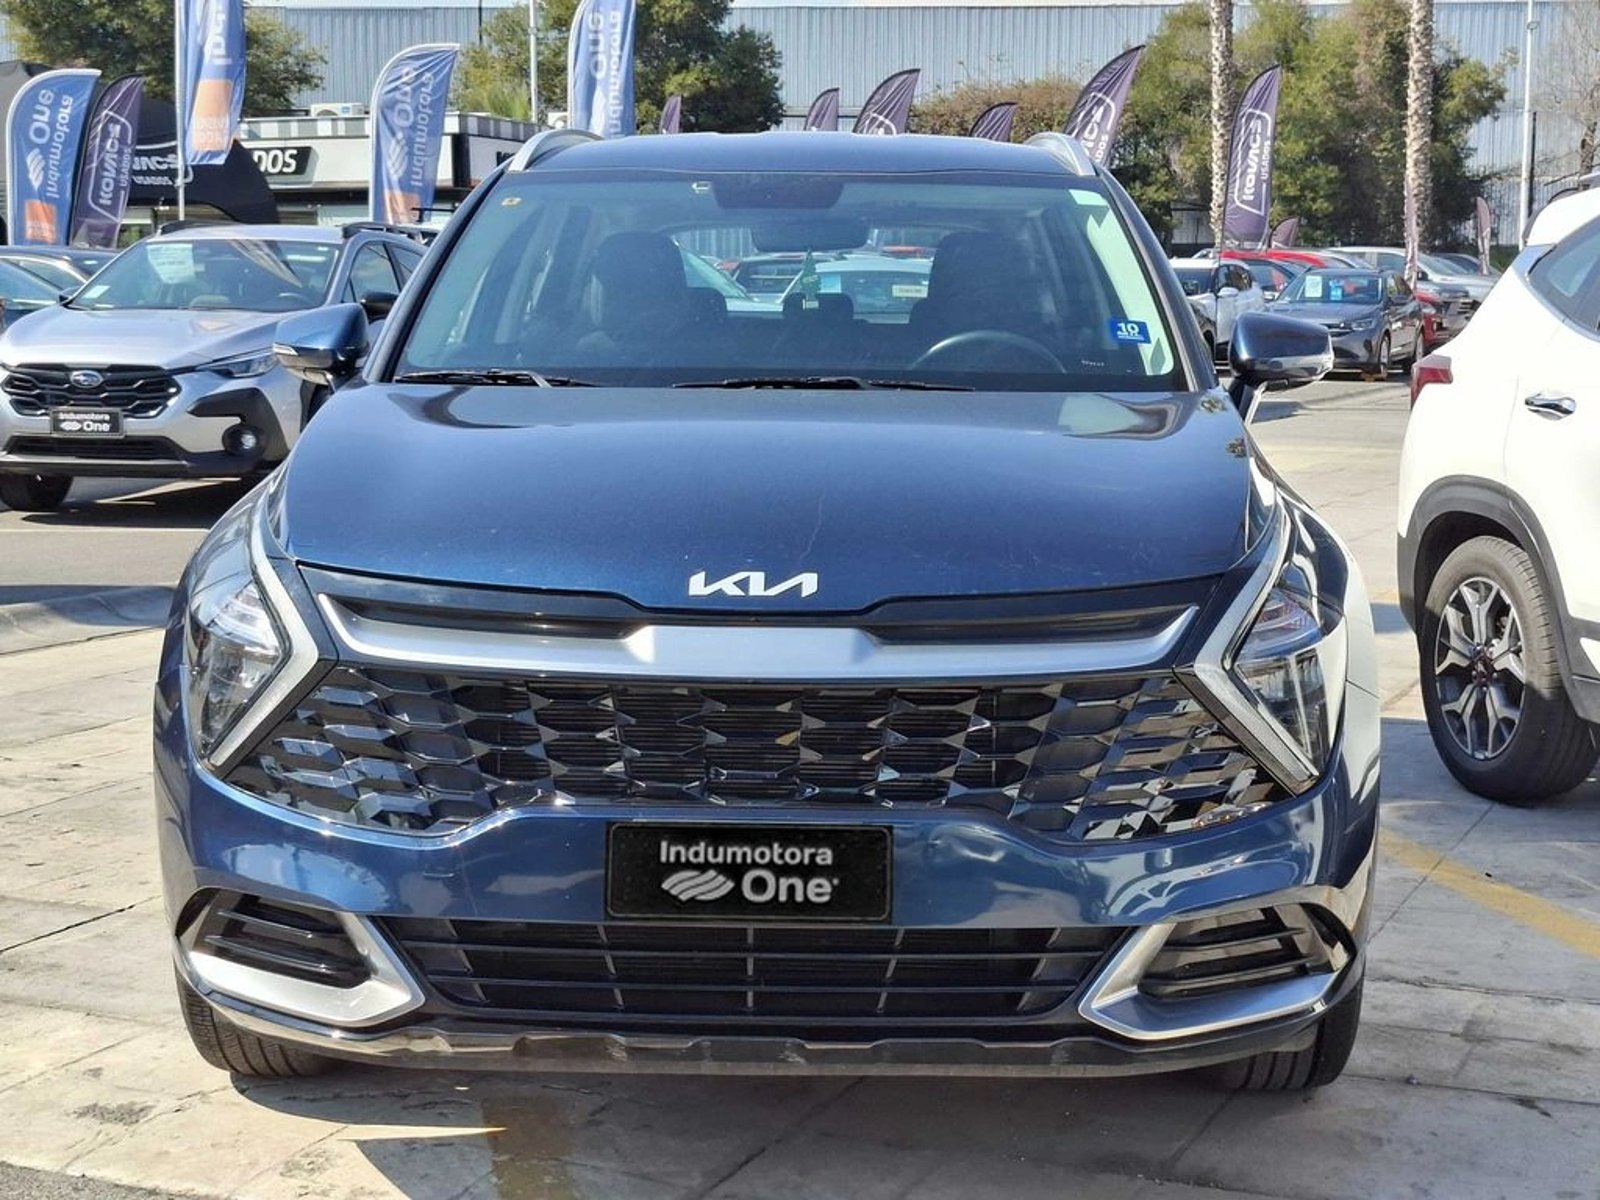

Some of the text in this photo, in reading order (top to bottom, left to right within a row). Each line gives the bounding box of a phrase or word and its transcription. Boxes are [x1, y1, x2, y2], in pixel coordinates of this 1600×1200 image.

[253, 149, 297, 174] DOS
[1096, 134, 1109, 159] DOS
[1242, 119, 1261, 201] KOVACS
[1260, 140, 1271, 180] USADOS
[99, 123, 121, 205] KOVACS
[119, 147, 132, 187] USADOS
[83, 421, 110, 432] One
[688, 571, 818, 597] KIA
[660, 840, 834, 867] Indumotora
[741, 869, 833, 904] One
